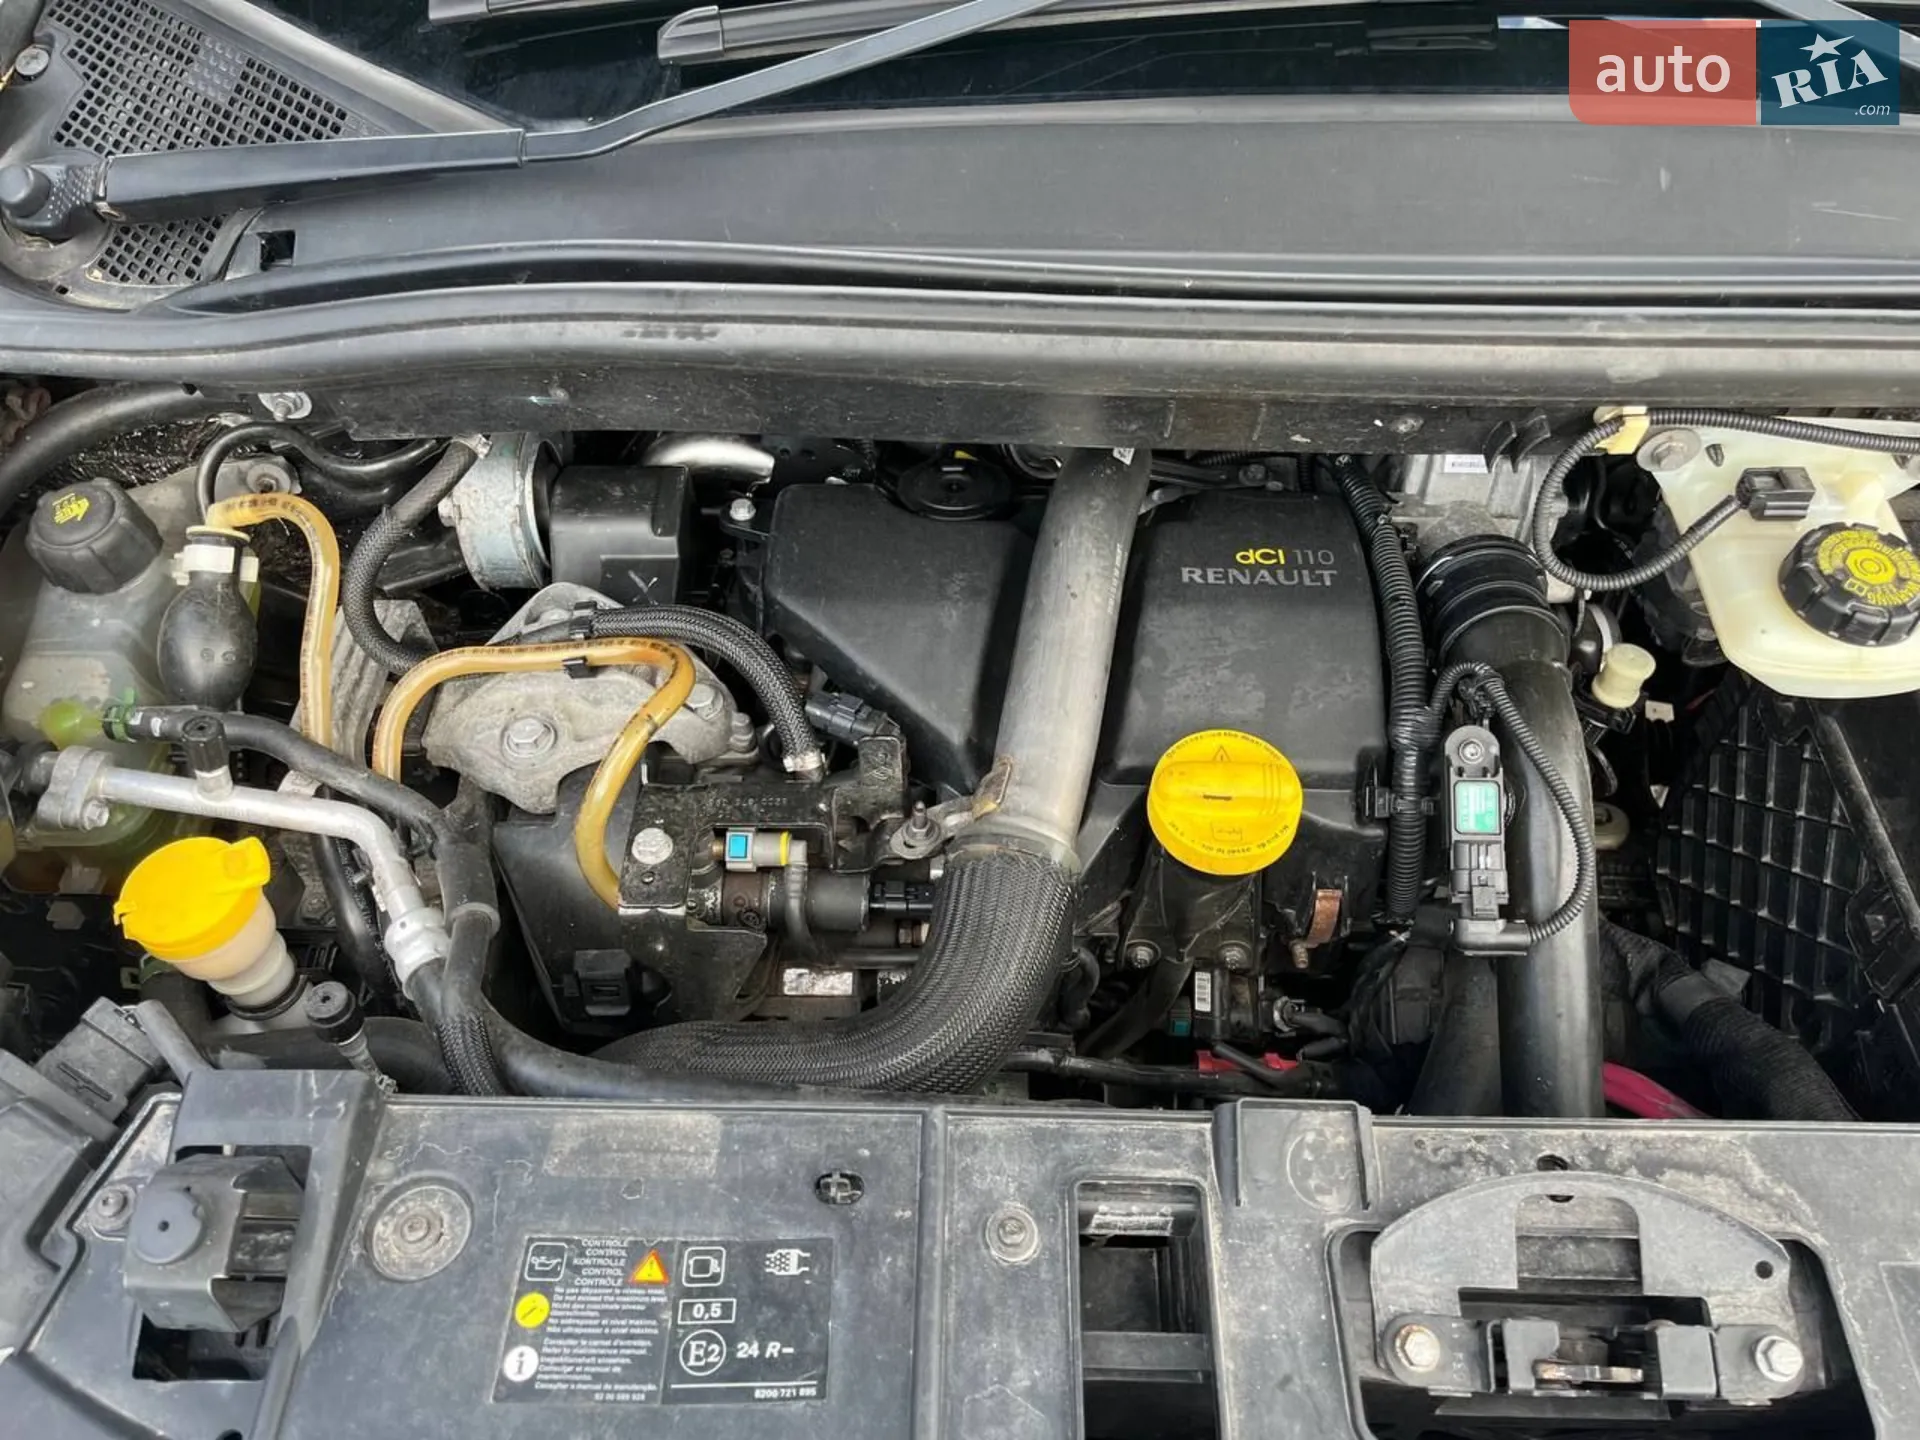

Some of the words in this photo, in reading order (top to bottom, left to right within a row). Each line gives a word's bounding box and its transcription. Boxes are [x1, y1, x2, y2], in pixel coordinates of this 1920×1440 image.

[1292, 549, 1335, 565] 110
[1180, 566, 1338, 587] RENAULT
[692, 1302, 722, 1321] 0,5
[687, 1340, 721, 1367] E2
[736, 1340, 760, 1358] 24
